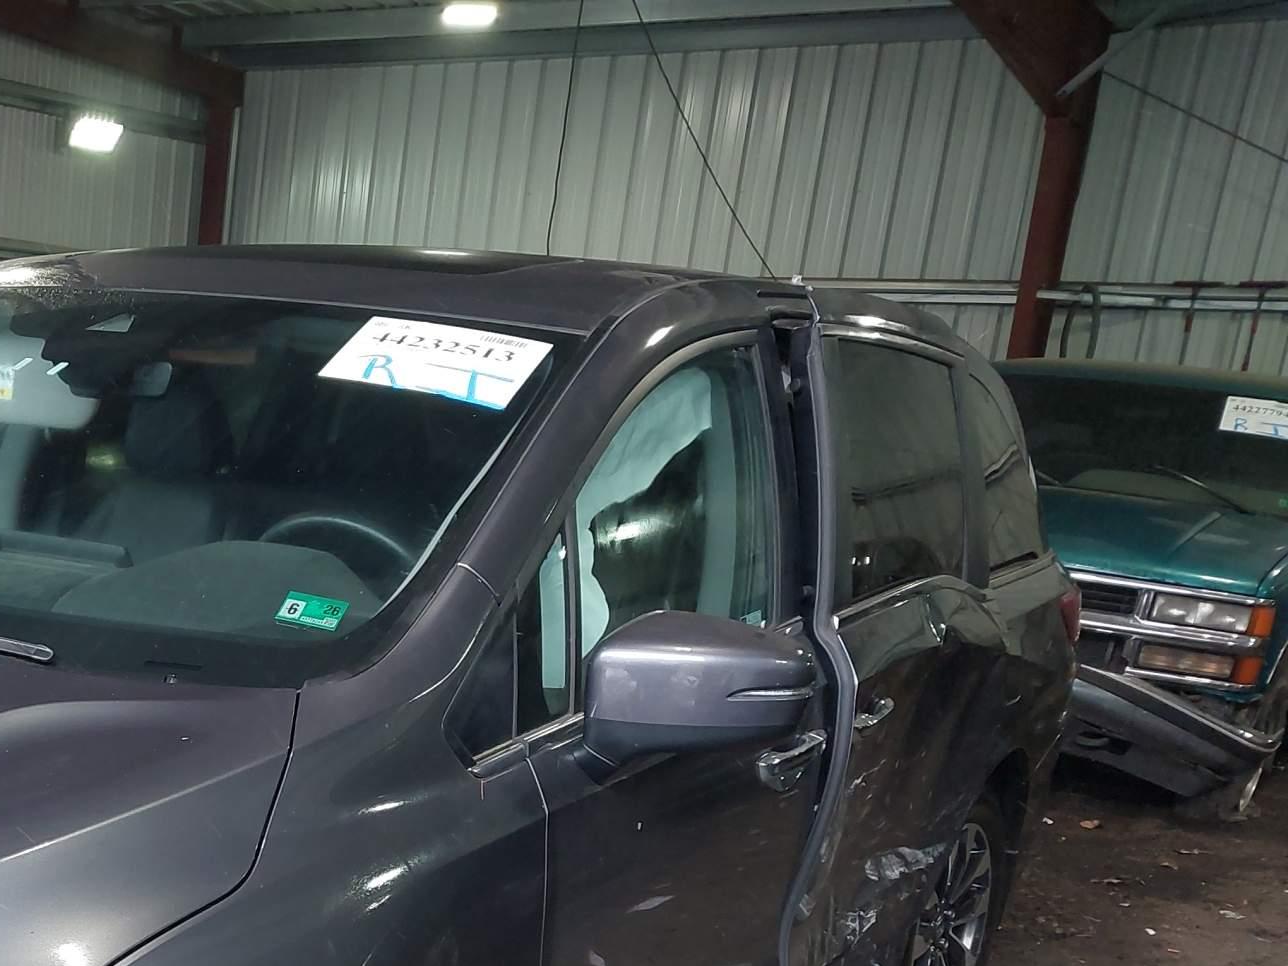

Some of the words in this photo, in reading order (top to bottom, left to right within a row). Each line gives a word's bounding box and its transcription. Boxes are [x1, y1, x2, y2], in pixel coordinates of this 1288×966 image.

[373, 331, 516, 363] 44232513
[360, 354, 406, 389] R
[287, 602, 300, 615] 6
[323, 604, 342, 616] 26
